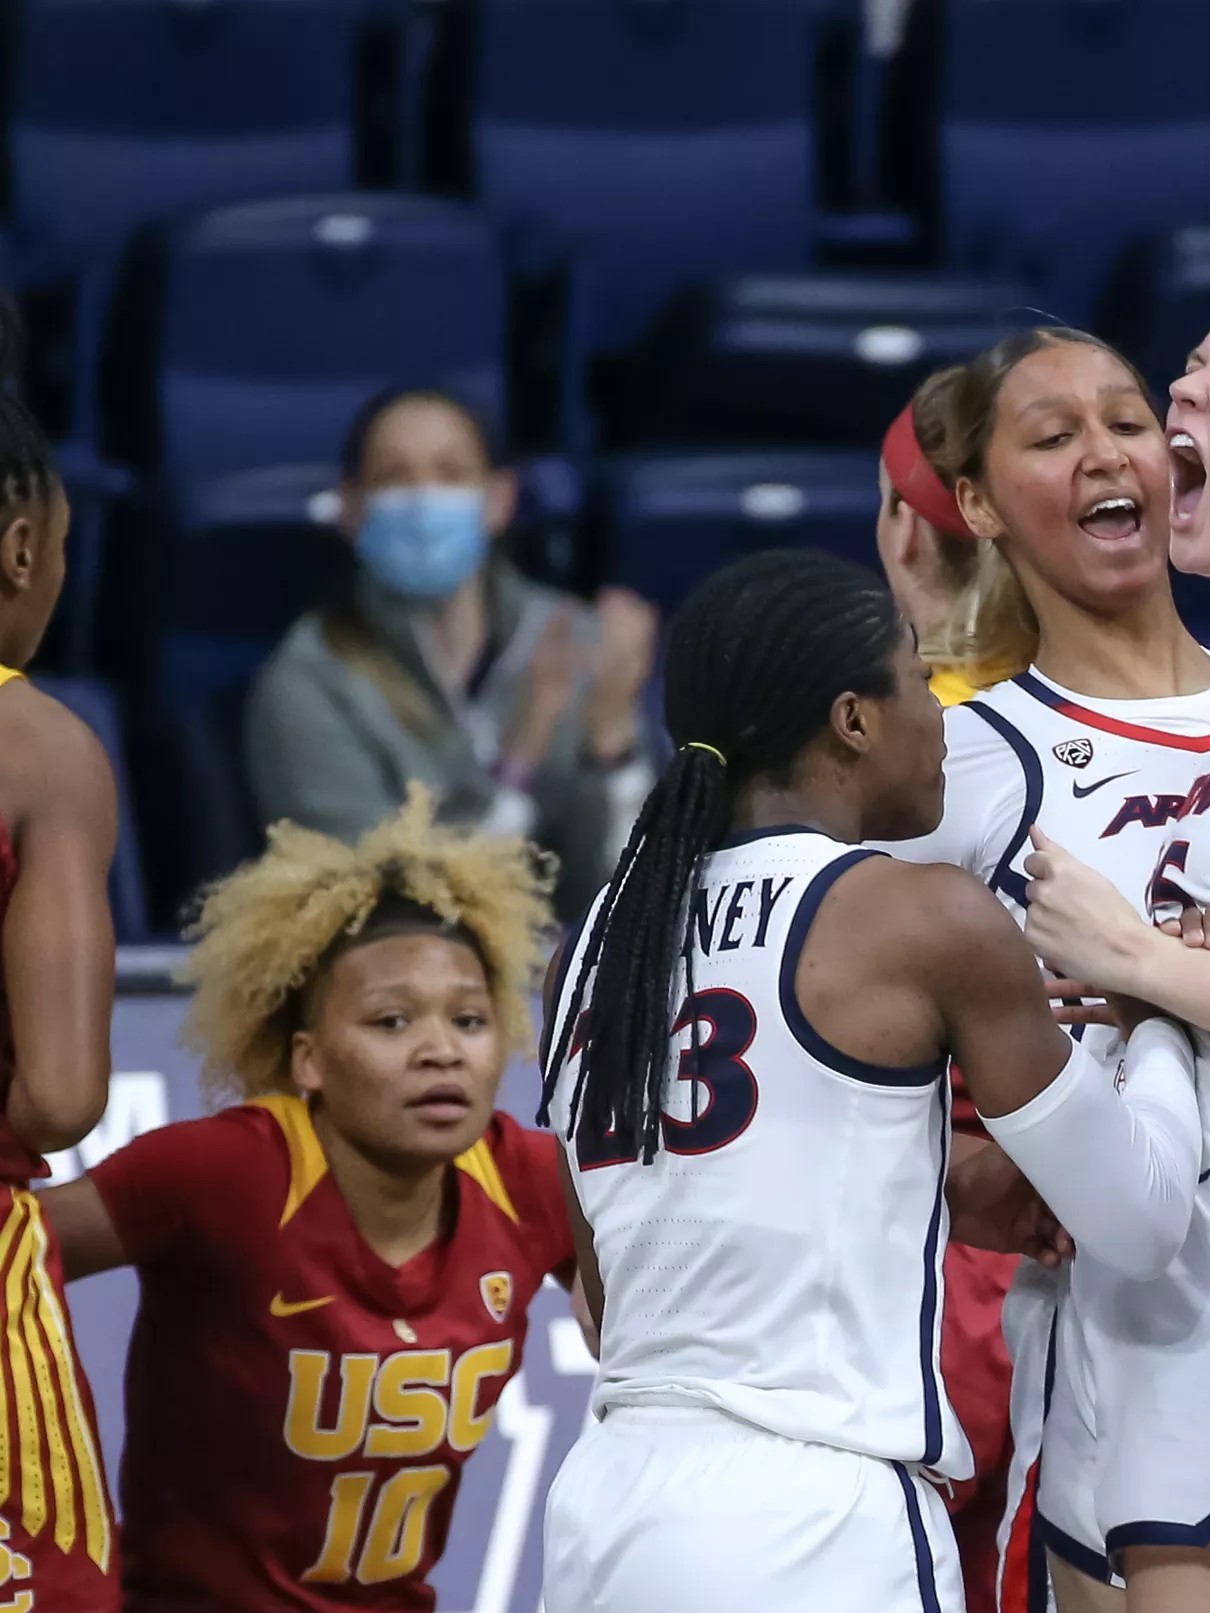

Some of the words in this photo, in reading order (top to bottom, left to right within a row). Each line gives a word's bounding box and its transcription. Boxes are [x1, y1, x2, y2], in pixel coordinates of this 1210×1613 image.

[680, 876, 795, 957] NEY
[283, 1339, 514, 1461] USC
[300, 1464, 450, 1586] 10
